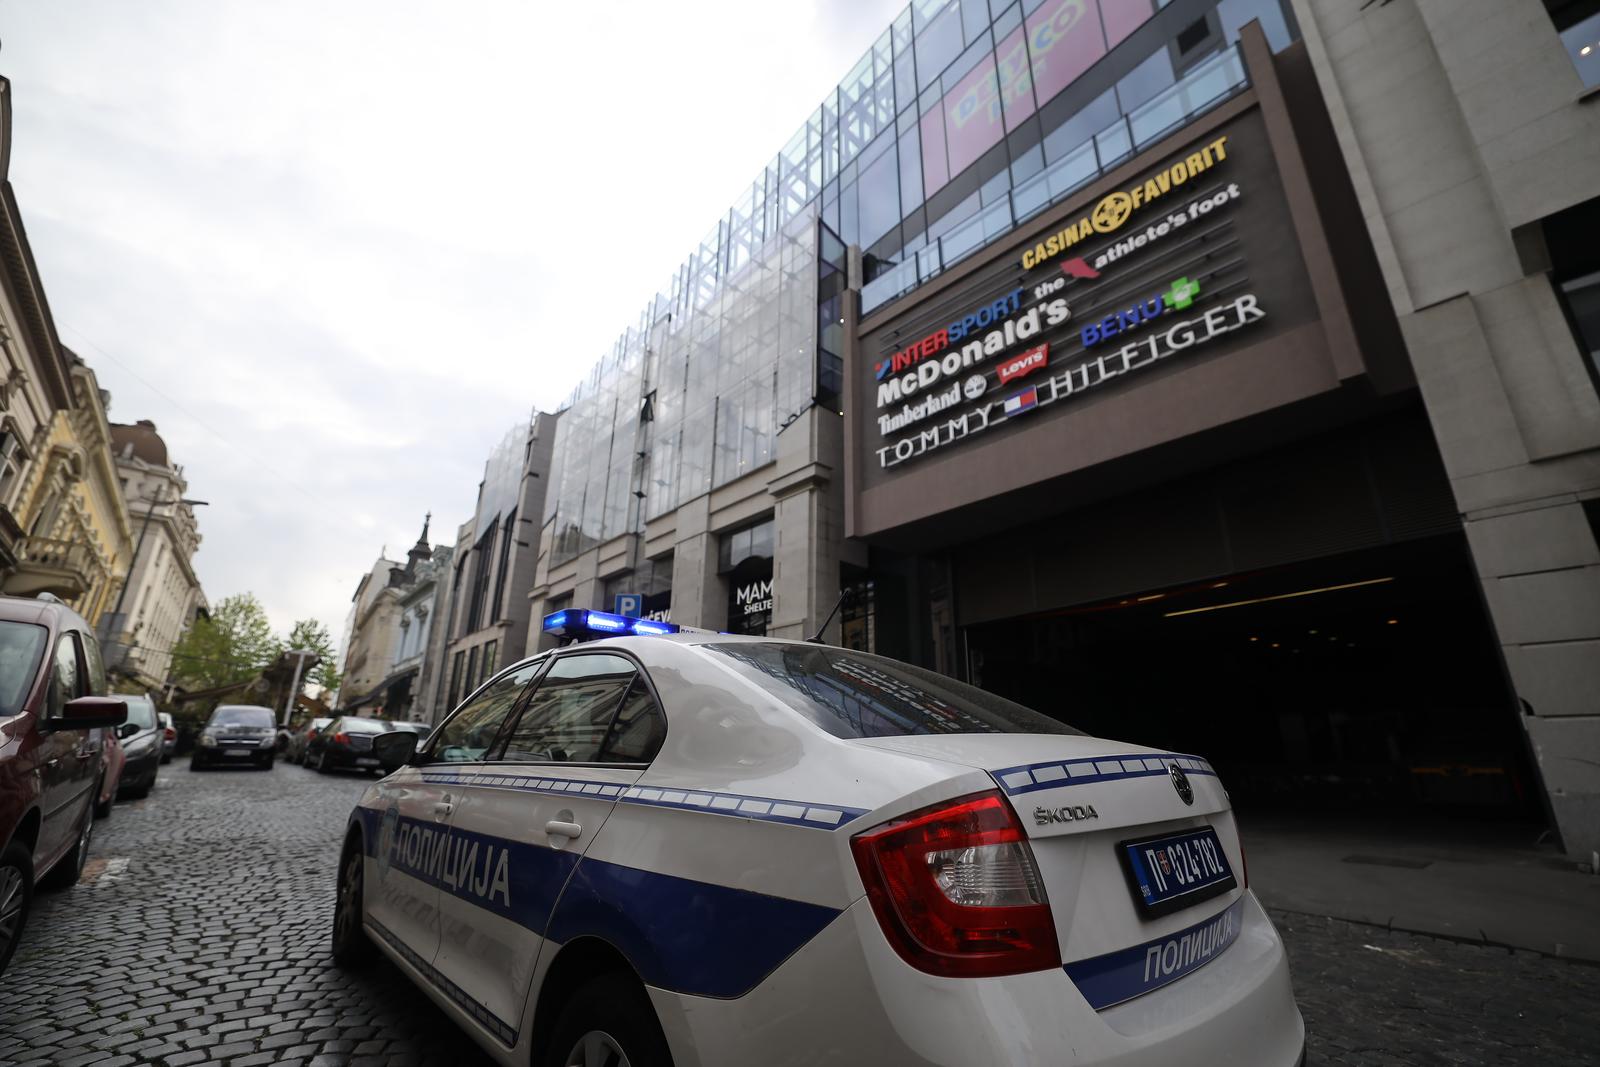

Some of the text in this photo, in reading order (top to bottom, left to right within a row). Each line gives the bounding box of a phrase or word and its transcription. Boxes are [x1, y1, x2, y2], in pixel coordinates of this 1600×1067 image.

[1022, 136, 1228, 270] CASINA FAVORIT
[1034, 183, 1240, 300] the athlete's foot
[876, 298, 1071, 408] McDonald's
[891, 288, 1024, 373] INTERSPORT
[1080, 294, 1165, 348] BENU
[876, 293, 1266, 468] TOMMY HILFIGER
[877, 382, 962, 436] Timberland
[1034, 805, 1099, 826] ŠKODA
[398, 821, 511, 908] ПОЛИЦИЈА
[1144, 911, 1232, 983] ПОЛИЦИЈА
